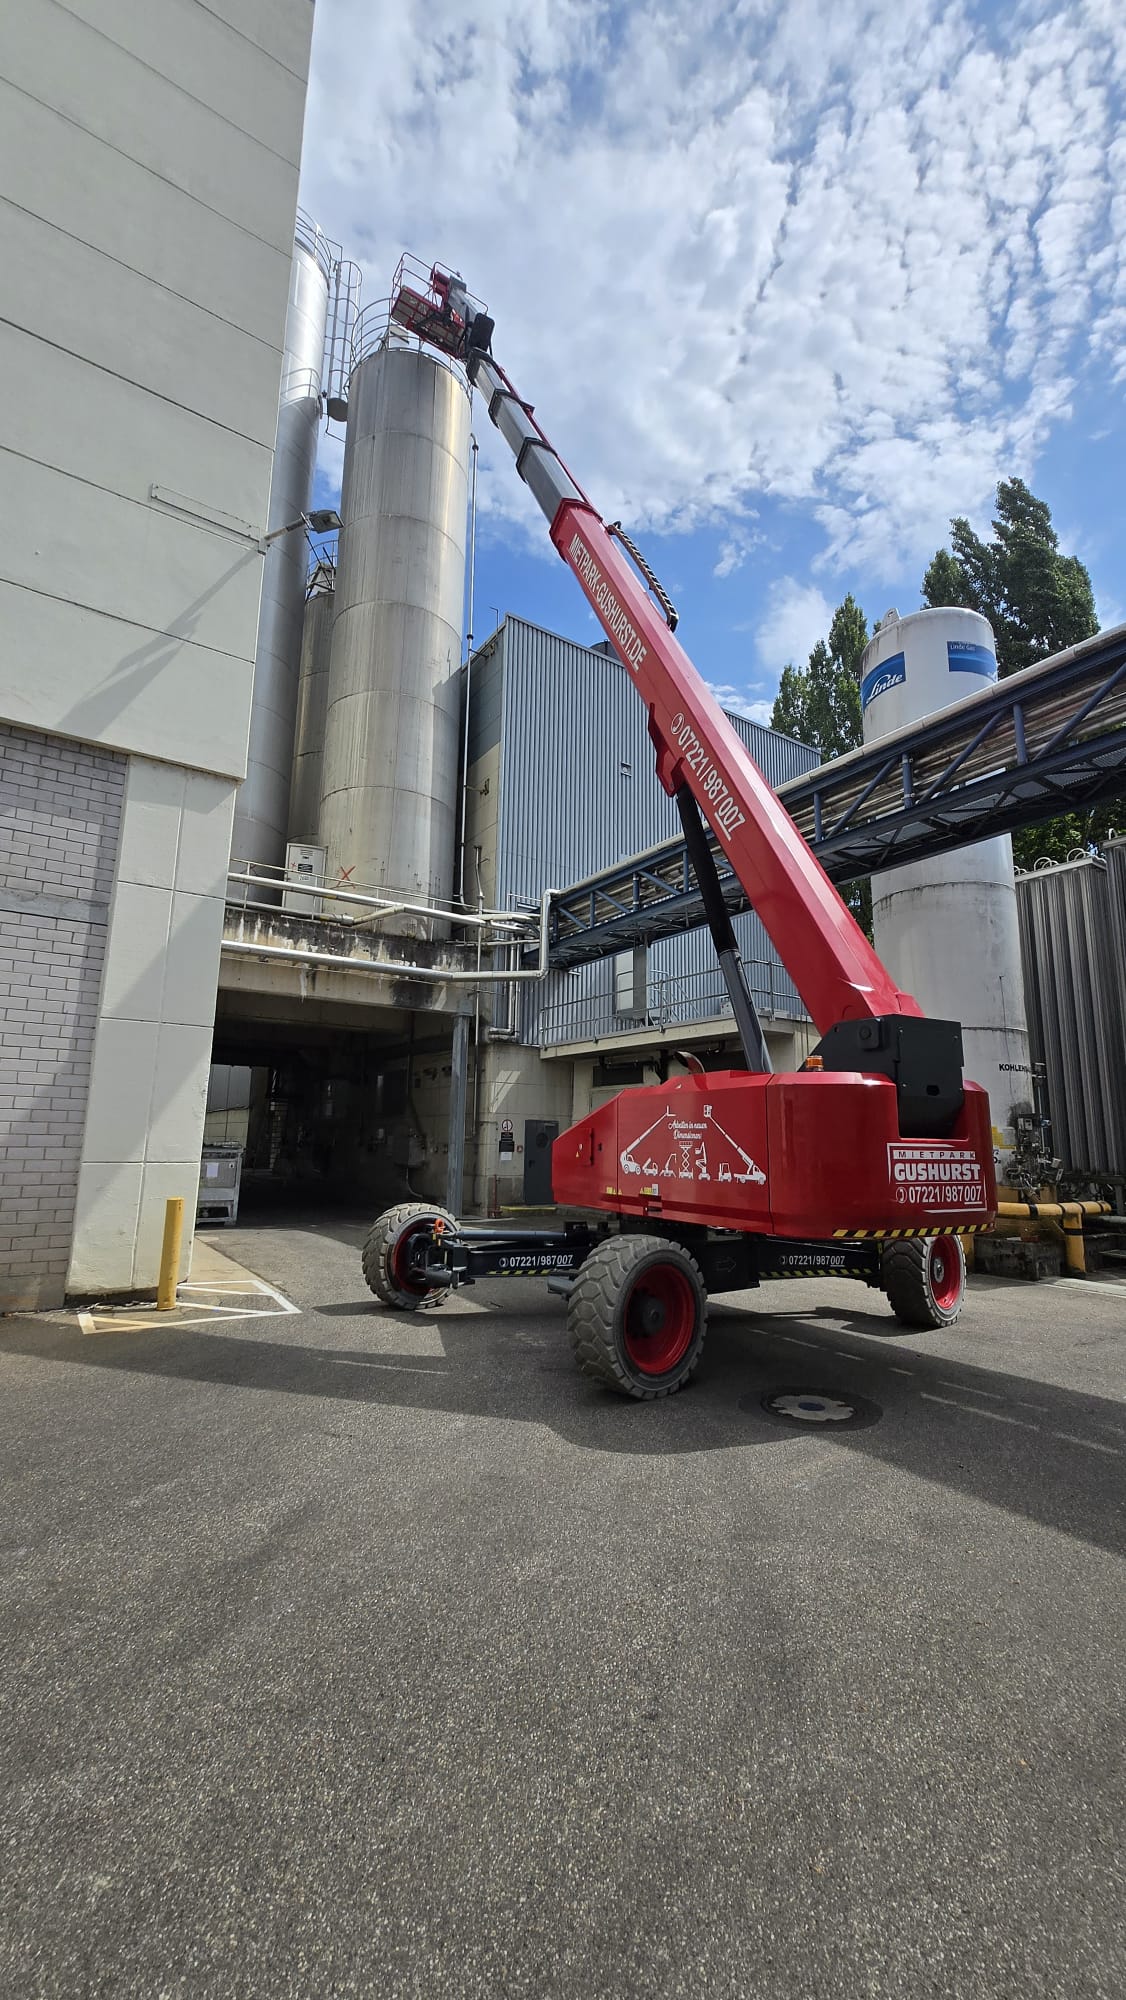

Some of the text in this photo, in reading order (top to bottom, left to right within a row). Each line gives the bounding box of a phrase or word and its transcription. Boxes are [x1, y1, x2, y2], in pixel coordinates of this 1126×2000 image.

[866, 674, 903, 704] Linde
[678, 725, 746, 840] 07221/987007
[898, 1151, 975, 1159] MIETPARK
[894, 1163, 981, 1181] GUSHURST
[908, 1185, 982, 1204] 07221/987007
[509, 1254, 574, 1268] 07221/987007
[788, 1255, 846, 1267] 07221/987007
